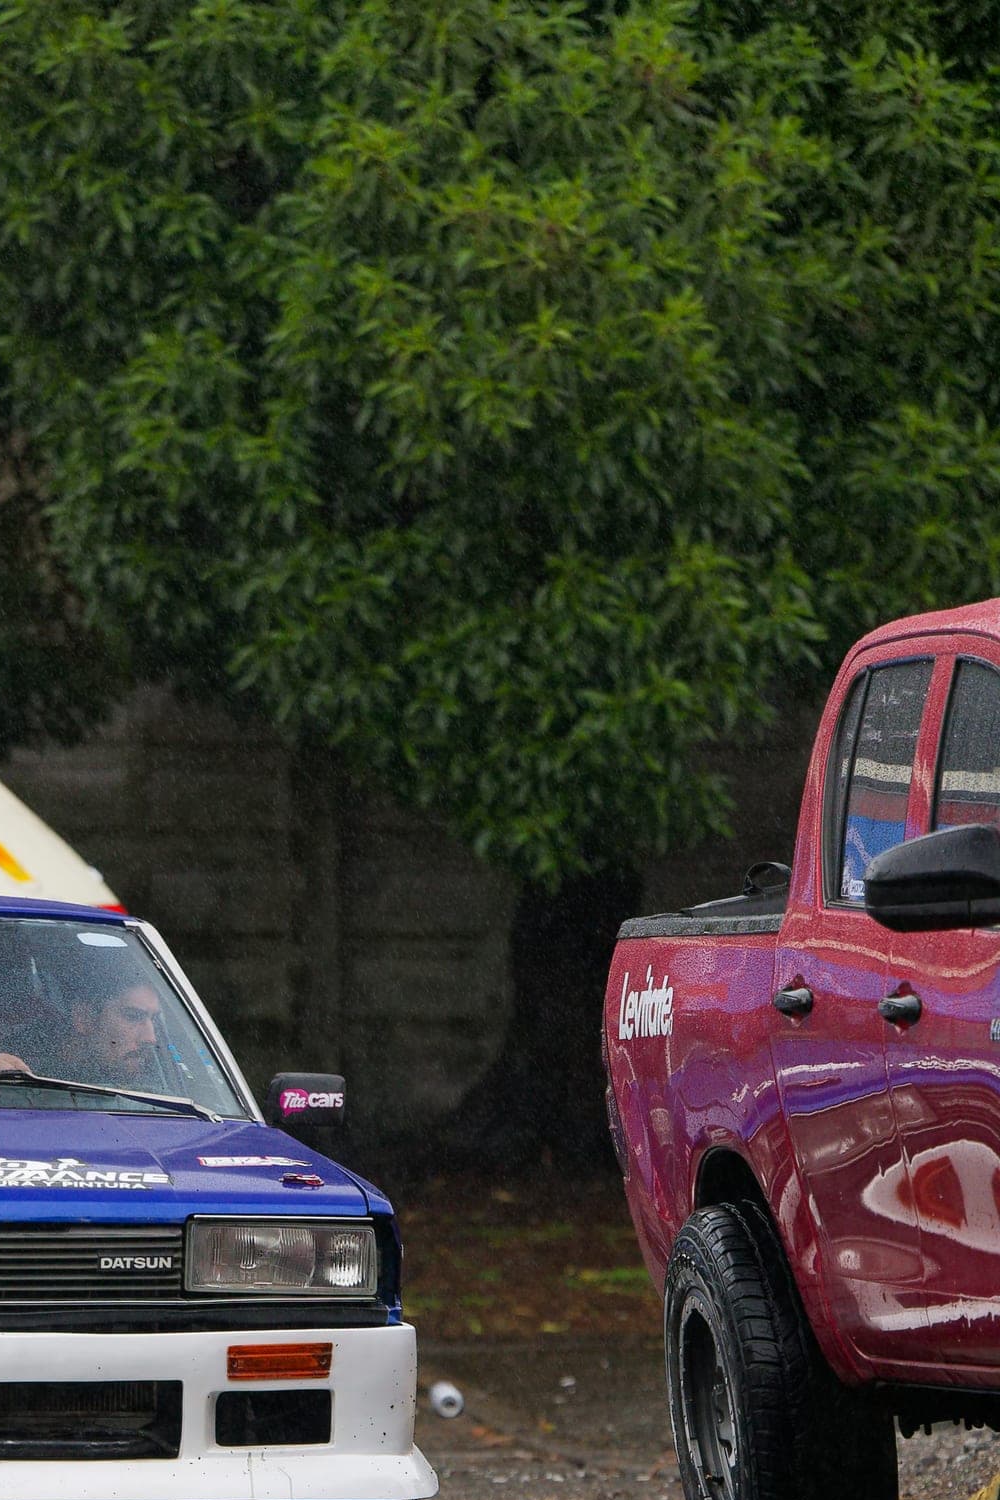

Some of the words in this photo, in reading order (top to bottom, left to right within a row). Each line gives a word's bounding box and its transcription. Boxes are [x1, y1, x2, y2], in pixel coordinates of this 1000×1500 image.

[618, 964, 674, 1040] Levitate
[42, 1180, 56, 1188] Y
[62, 1181, 147, 1190] PINTURA
[100, 1256, 172, 1269] DATSUN
